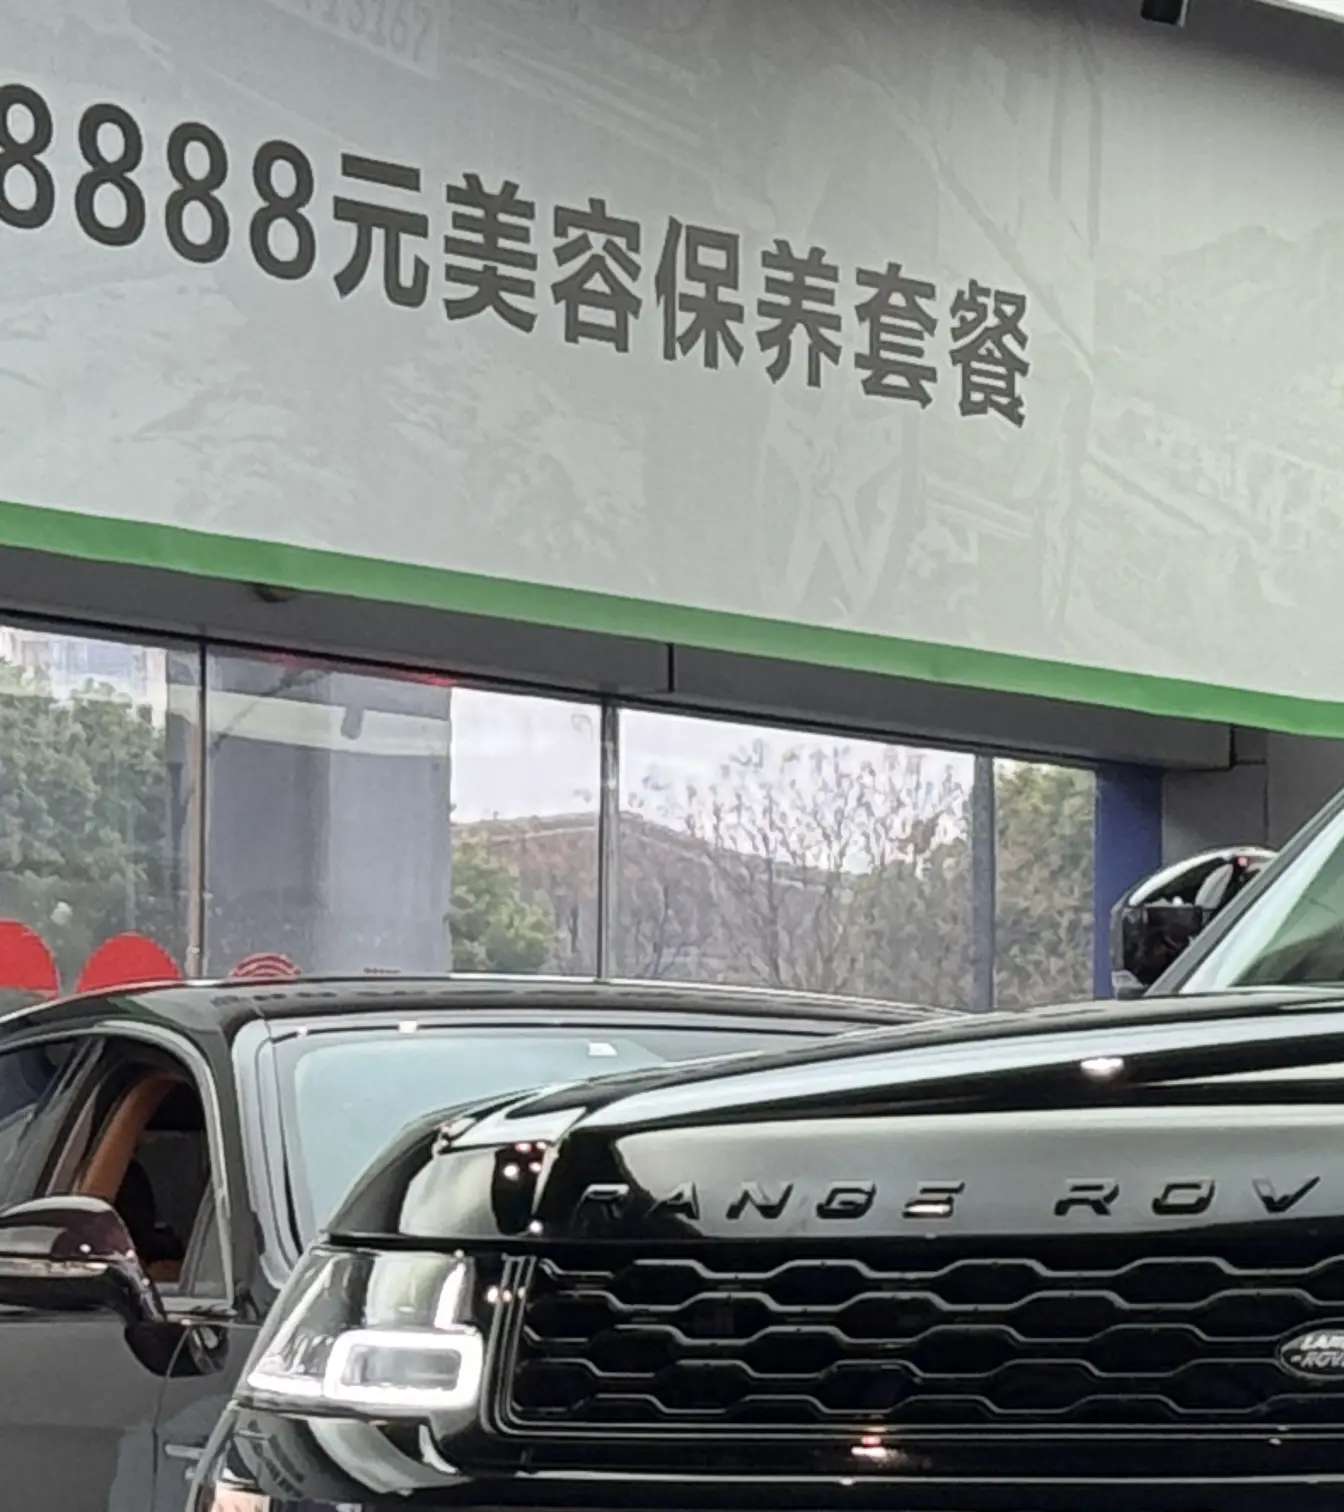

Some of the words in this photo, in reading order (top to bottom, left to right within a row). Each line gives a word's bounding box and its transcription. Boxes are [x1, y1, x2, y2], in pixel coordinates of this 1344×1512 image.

[0, 83, 1030, 427] 8888元美容保养套餐
[571, 1180, 965, 1227] RANGE
